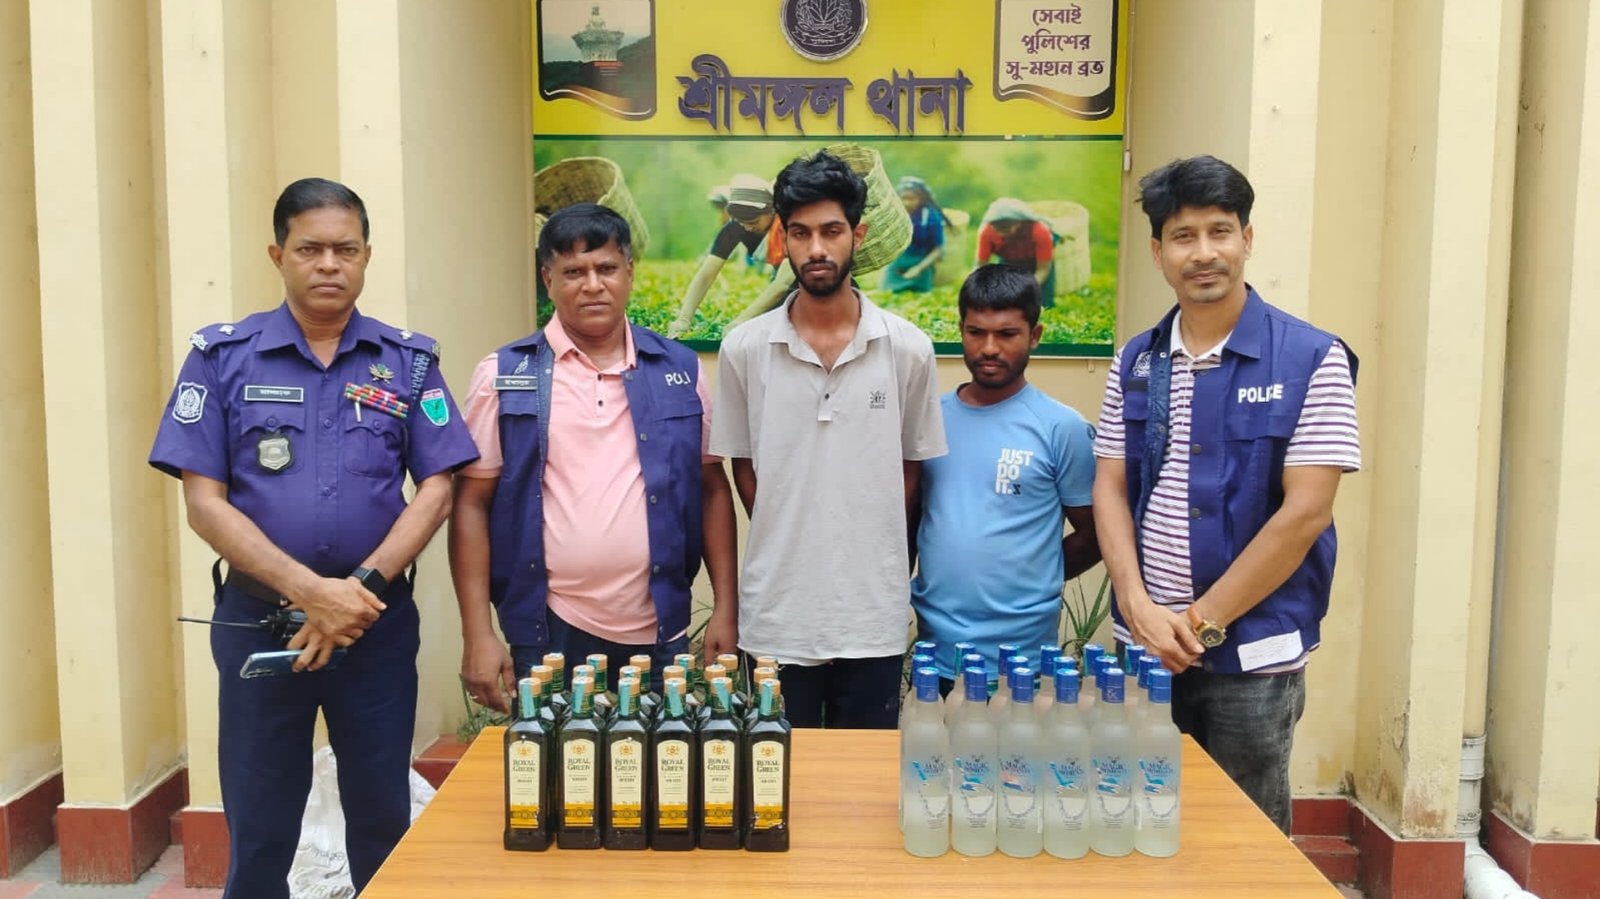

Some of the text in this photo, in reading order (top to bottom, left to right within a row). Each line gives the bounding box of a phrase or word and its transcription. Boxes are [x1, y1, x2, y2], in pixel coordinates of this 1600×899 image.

[1032, 4, 1082, 25] সেবাই
[1021, 29, 1091, 54] পুলিশের
[1005, 60, 1105, 80] সু-মহান ব্রত
[675, 54, 974, 135] শ্রীমঙ্গল থানা
[998, 448, 1034, 466] JUST
[997, 463, 1020, 480] DO
